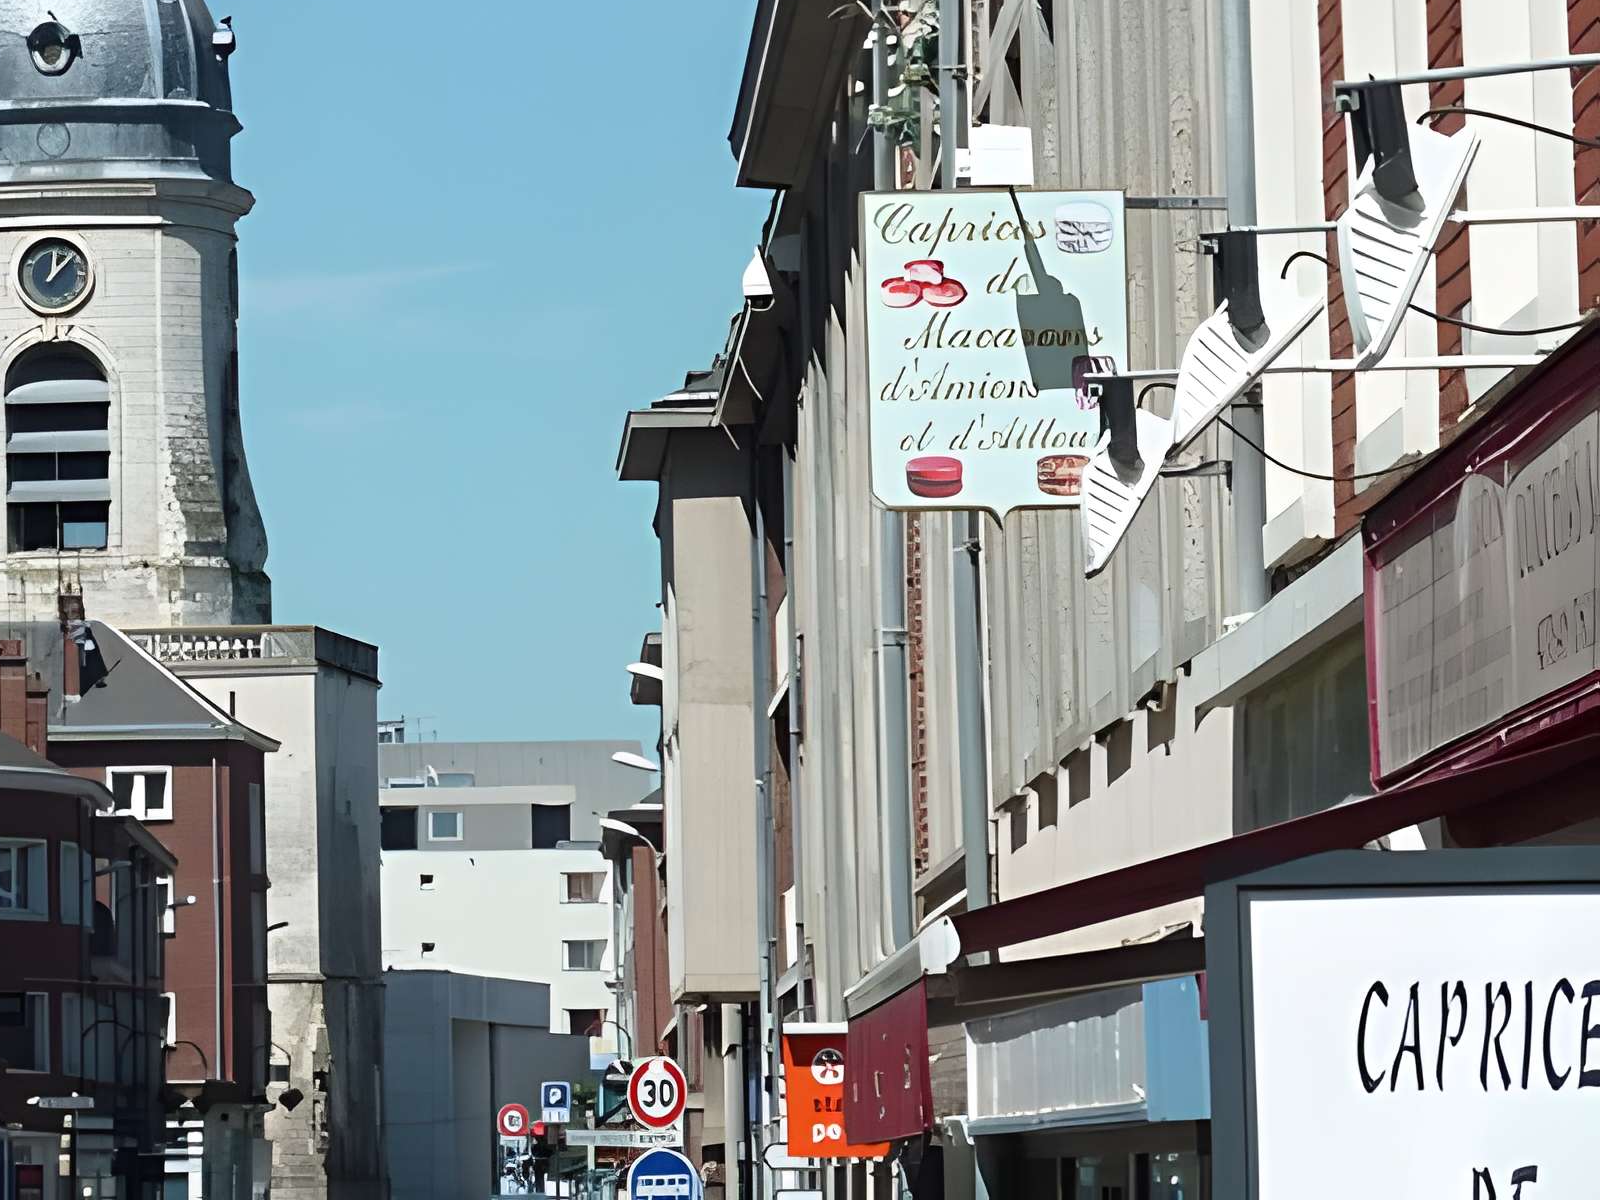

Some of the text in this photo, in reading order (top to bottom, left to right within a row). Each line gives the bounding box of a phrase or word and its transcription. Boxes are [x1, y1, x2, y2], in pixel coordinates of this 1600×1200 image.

[903, 310, 1104, 350] Macarons
[948, 412, 1101, 451] d'Ailleu
[1356, 977, 1600, 1093] CAPRICE
[642, 1078, 675, 1108] 30
